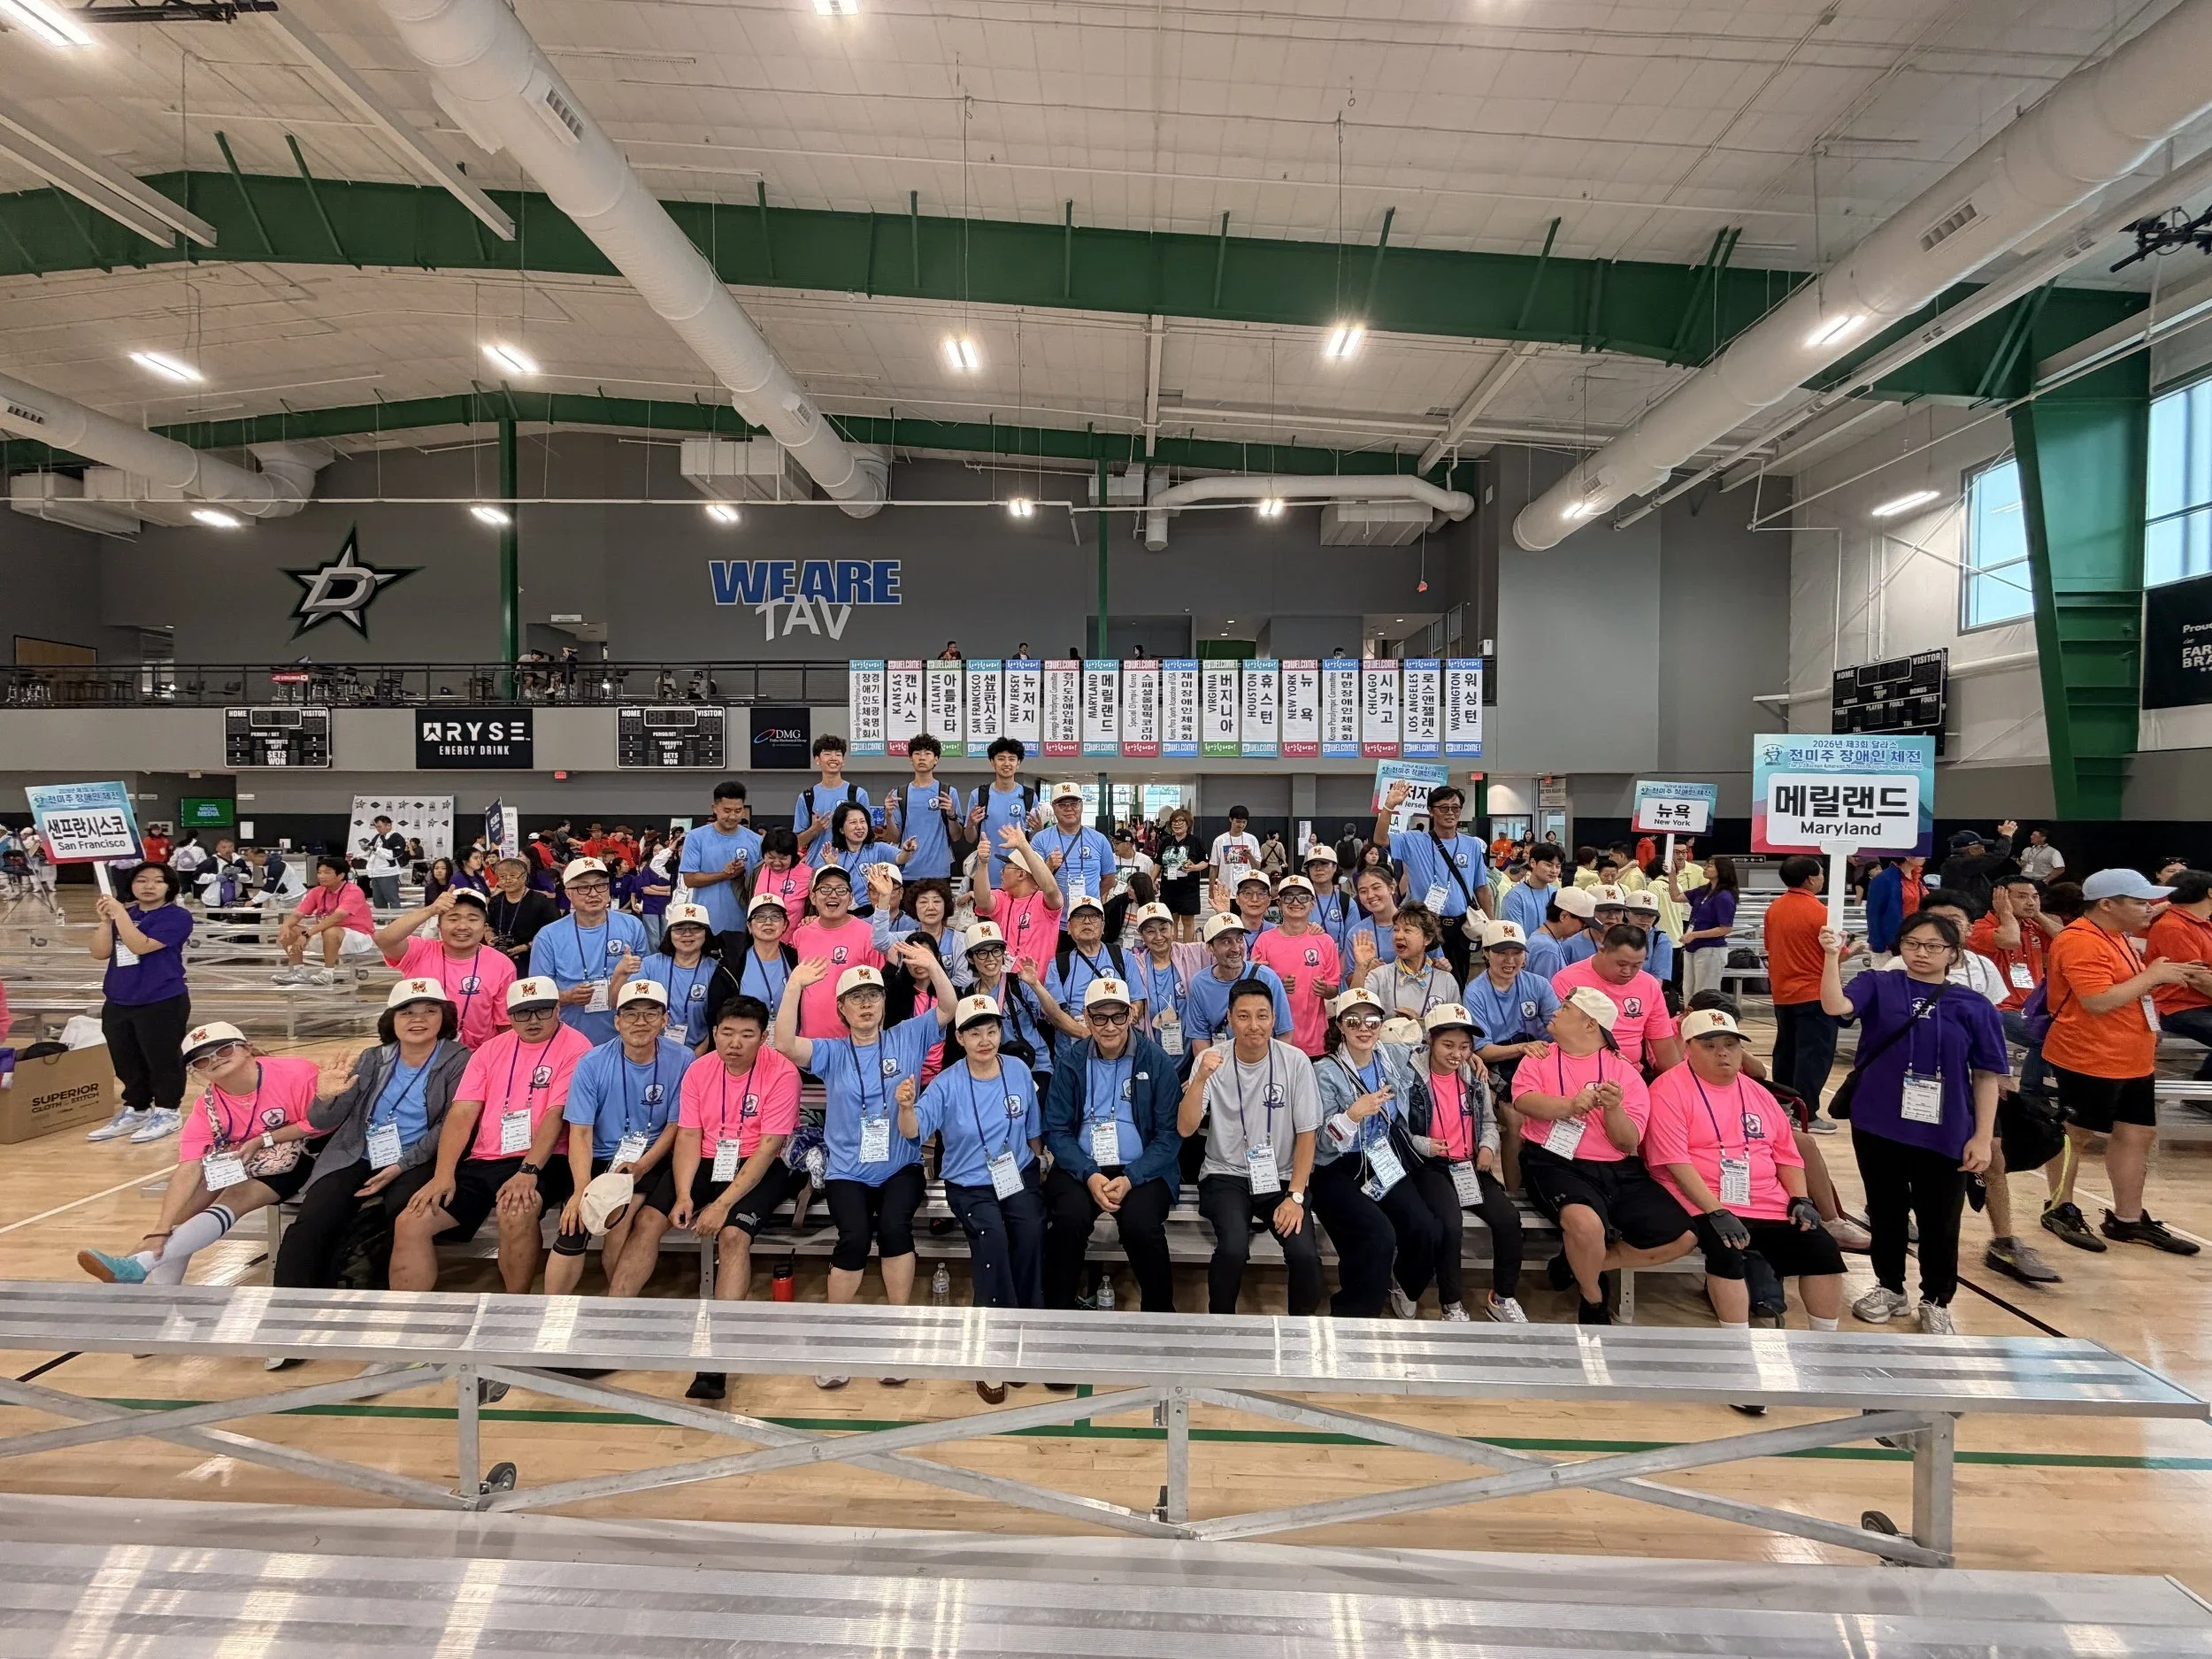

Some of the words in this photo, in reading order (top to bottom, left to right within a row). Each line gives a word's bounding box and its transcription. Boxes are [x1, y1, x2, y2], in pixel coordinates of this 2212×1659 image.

[709, 560, 795, 605] WE
[798, 559, 902, 604] ARE
[755, 594, 851, 641] TAV
[895, 660, 921, 669] WELCOME!
[1052, 660, 1079, 669] WELCOME!
[1131, 660, 1158, 669] WELCOME!
[1290, 660, 1317, 669] WELCOME!
[1913, 653, 1940, 665] VISITOR
[1287, 674, 1296, 698] YORK
[1837, 670, 1855, 680] HOME
[893, 674, 902, 714] KANSAS
[904, 674, 917, 722] 캔사스
[932, 674, 941, 713] ATLANTA
[1010, 674, 1019, 702] JERSEY
[1023, 674, 1035, 723] 뉴저지
[1088, 673, 1097, 718] MARYLAND
[1128, 690, 1138, 709] Olympic
[1208, 674, 1217, 713] VIRGINIA
[1248, 674, 1256, 718] HOUSTON
[1261, 674, 1272, 725] 휴스턴
[1301, 674, 1313, 722] 뉴욕
[1368, 674, 1377, 715] CHICAGO
[1380, 674, 1394, 724] 시카고
[1409, 673, 1417, 713] ANGELES
[1464, 673, 1478, 724] 워싱턴
[944, 674, 956, 733] 아틀란타
[984, 674, 996, 734] 샌프란시스코
[1010, 704, 1018, 723] NEW
[1063, 672, 1073, 741] 경기도장애인체육회
[1101, 674, 1113, 732] 메릴랜드
[1141, 673, 1153, 741] 스페셜올림픽코리아
[1181, 672, 1192, 741] 재미장애인체육회
[1220, 674, 1233, 733] 버지니아
[1287, 700, 1296, 719] NEW
[1327, 699, 1338, 726] Paralympic
[1341, 672, 1353, 741] 대한장애인체육회
[1421, 673, 1434, 738] 로스앤젤레스
[1451, 672, 1460, 731] WASHINGTON
[972, 716, 981, 733] SAN
[1128, 710, 1138, 727] Special
[1409, 717, 1417, 733] LOS
[447, 722, 525, 741] RYSE
[776, 729, 801, 739] DMG
[439, 745, 475, 756] ENERGY
[480, 745, 510, 756] DRINK
[857, 742, 884, 751] WELCOME!
[1330, 743, 1357, 752] WELCOME!
[1410, 743, 1439, 752] WELCOME!
[1453, 743, 1481, 752] WELCOME!
[1789, 749, 1834, 763] 전미주
[1840, 749, 1885, 763] 장애인
[1891, 750, 1921, 764] 체전
[1872, 740, 1898, 749] 달라스
[48, 794, 73, 804] 전미주
[1656, 803, 1690, 818] 뉴욕
[1775, 785, 1909, 818] 메릴랜드
[47, 816, 127, 840] 샌프란시스코
[1801, 821, 1881, 836] Maryland
[58, 841, 77, 850] San
[79, 840, 126, 849] Francisco
[32, 1083, 99, 1106] SUPERIOR
[32, 1102, 61, 1113] CLOTH
[71, 1092, 99, 1103] STITCH
